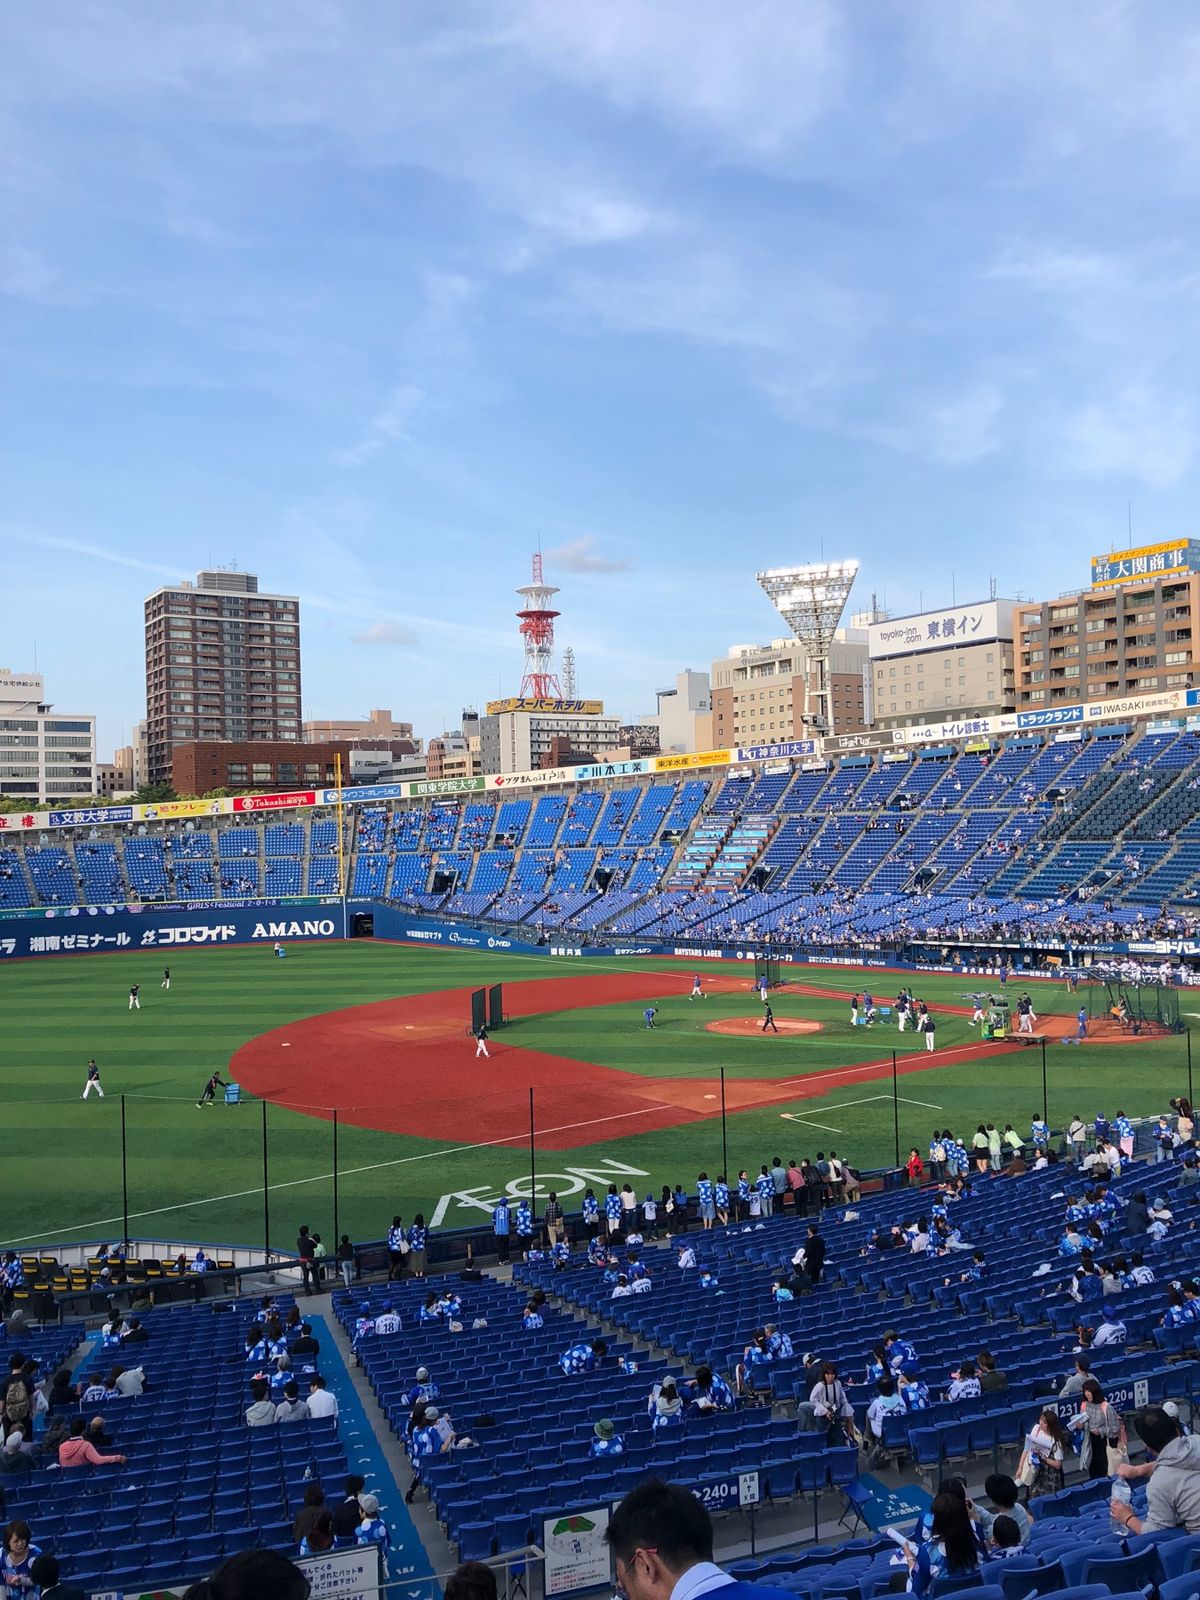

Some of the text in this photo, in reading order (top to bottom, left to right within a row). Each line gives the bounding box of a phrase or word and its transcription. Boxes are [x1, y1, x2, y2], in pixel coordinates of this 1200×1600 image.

[1112, 549, 1184, 579] 大関商事
[880, 627, 918, 642] toyoko-inn
[926, 615, 983, 640] 東横イン
[904, 634, 922, 644] .com
[515, 698, 585, 711] スーパーホテル
[1103, 700, 1144, 714] IWASAKI
[1020, 708, 1081, 726] トラックランド
[941, 720, 990, 737] トイレ診断士
[759, 742, 811, 757] 神奈川大学
[591, 761, 642, 778] 川本工業
[657, 757, 689, 768] 東洋水産
[505, 769, 566, 785] ブタまんの江戸清
[417, 779, 478, 794] 関東学院大学
[255, 796, 308, 807] Takashimaya
[61, 810, 109, 825] 文教大学
[158, 924, 237, 944] コロワイド
[252, 920, 335, 938] AMANO
[29, 932, 131, 952] 湘南ゼミナール
[674, 947, 722, 958] BAYSTARS LAGER
[1108, 1389, 1127, 1404] 220
[1059, 1402, 1078, 1418] 231
[703, 1483, 728, 1501] 240
